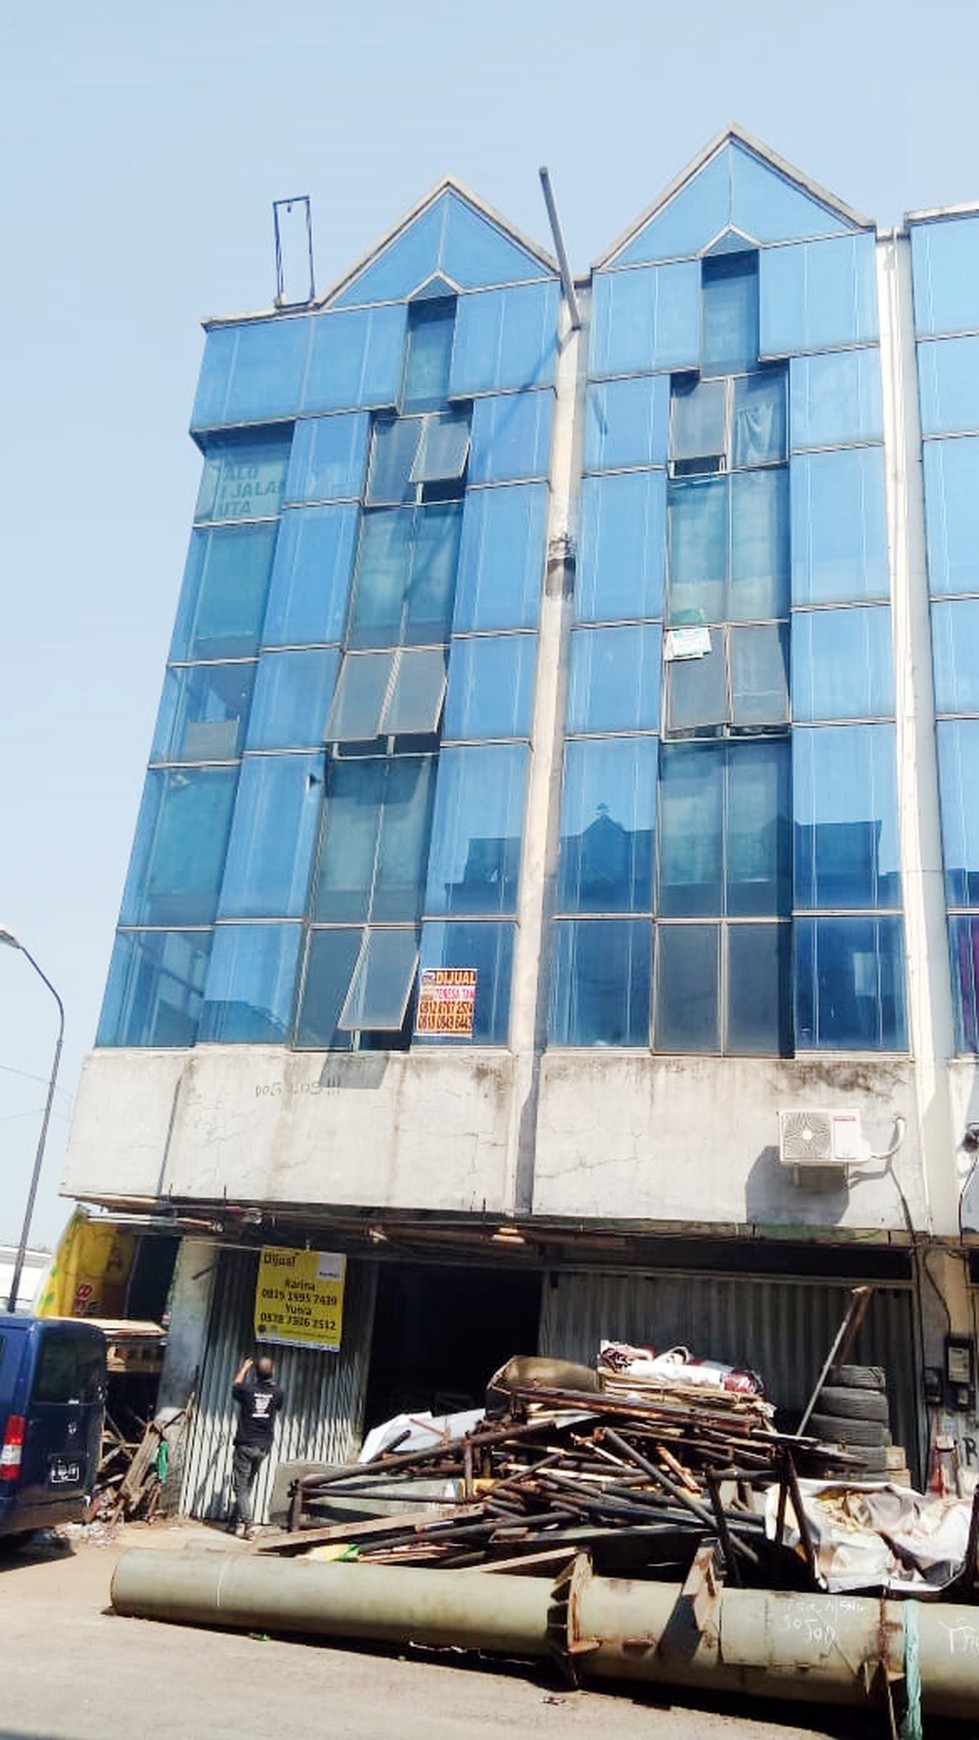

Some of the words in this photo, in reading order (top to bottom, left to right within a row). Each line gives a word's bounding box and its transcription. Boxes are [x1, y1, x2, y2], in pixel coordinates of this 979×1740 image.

[436, 971, 477, 985] DIJUAL
[263, 1252, 296, 1267] Dijual
[283, 1279, 316, 1292] Karina
